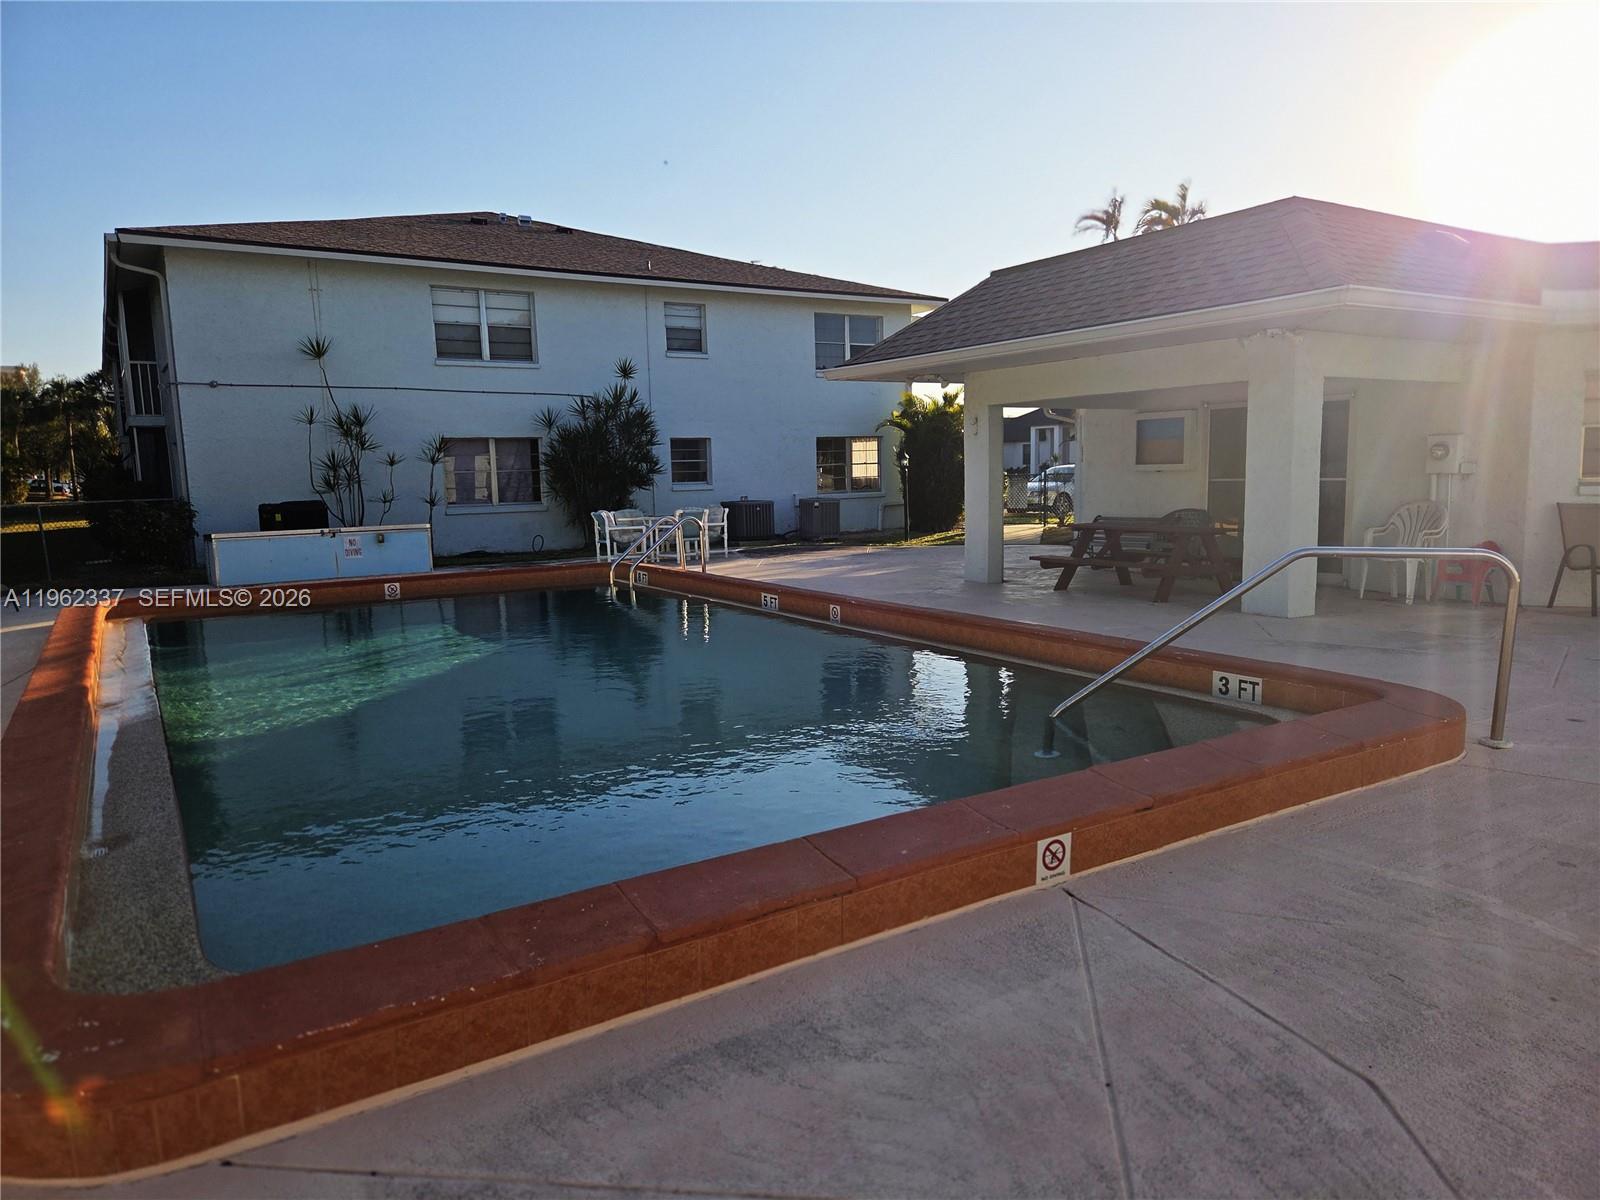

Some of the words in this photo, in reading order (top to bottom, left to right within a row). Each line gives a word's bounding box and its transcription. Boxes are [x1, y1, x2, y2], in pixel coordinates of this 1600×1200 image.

[348, 538, 357, 546] NO
[345, 548, 362, 557] DIVING
[763, 595, 768, 607] 5
[770, 596, 778, 609] FT
[1218, 676, 1230, 696] 3
[1238, 679, 1260, 702] FT
